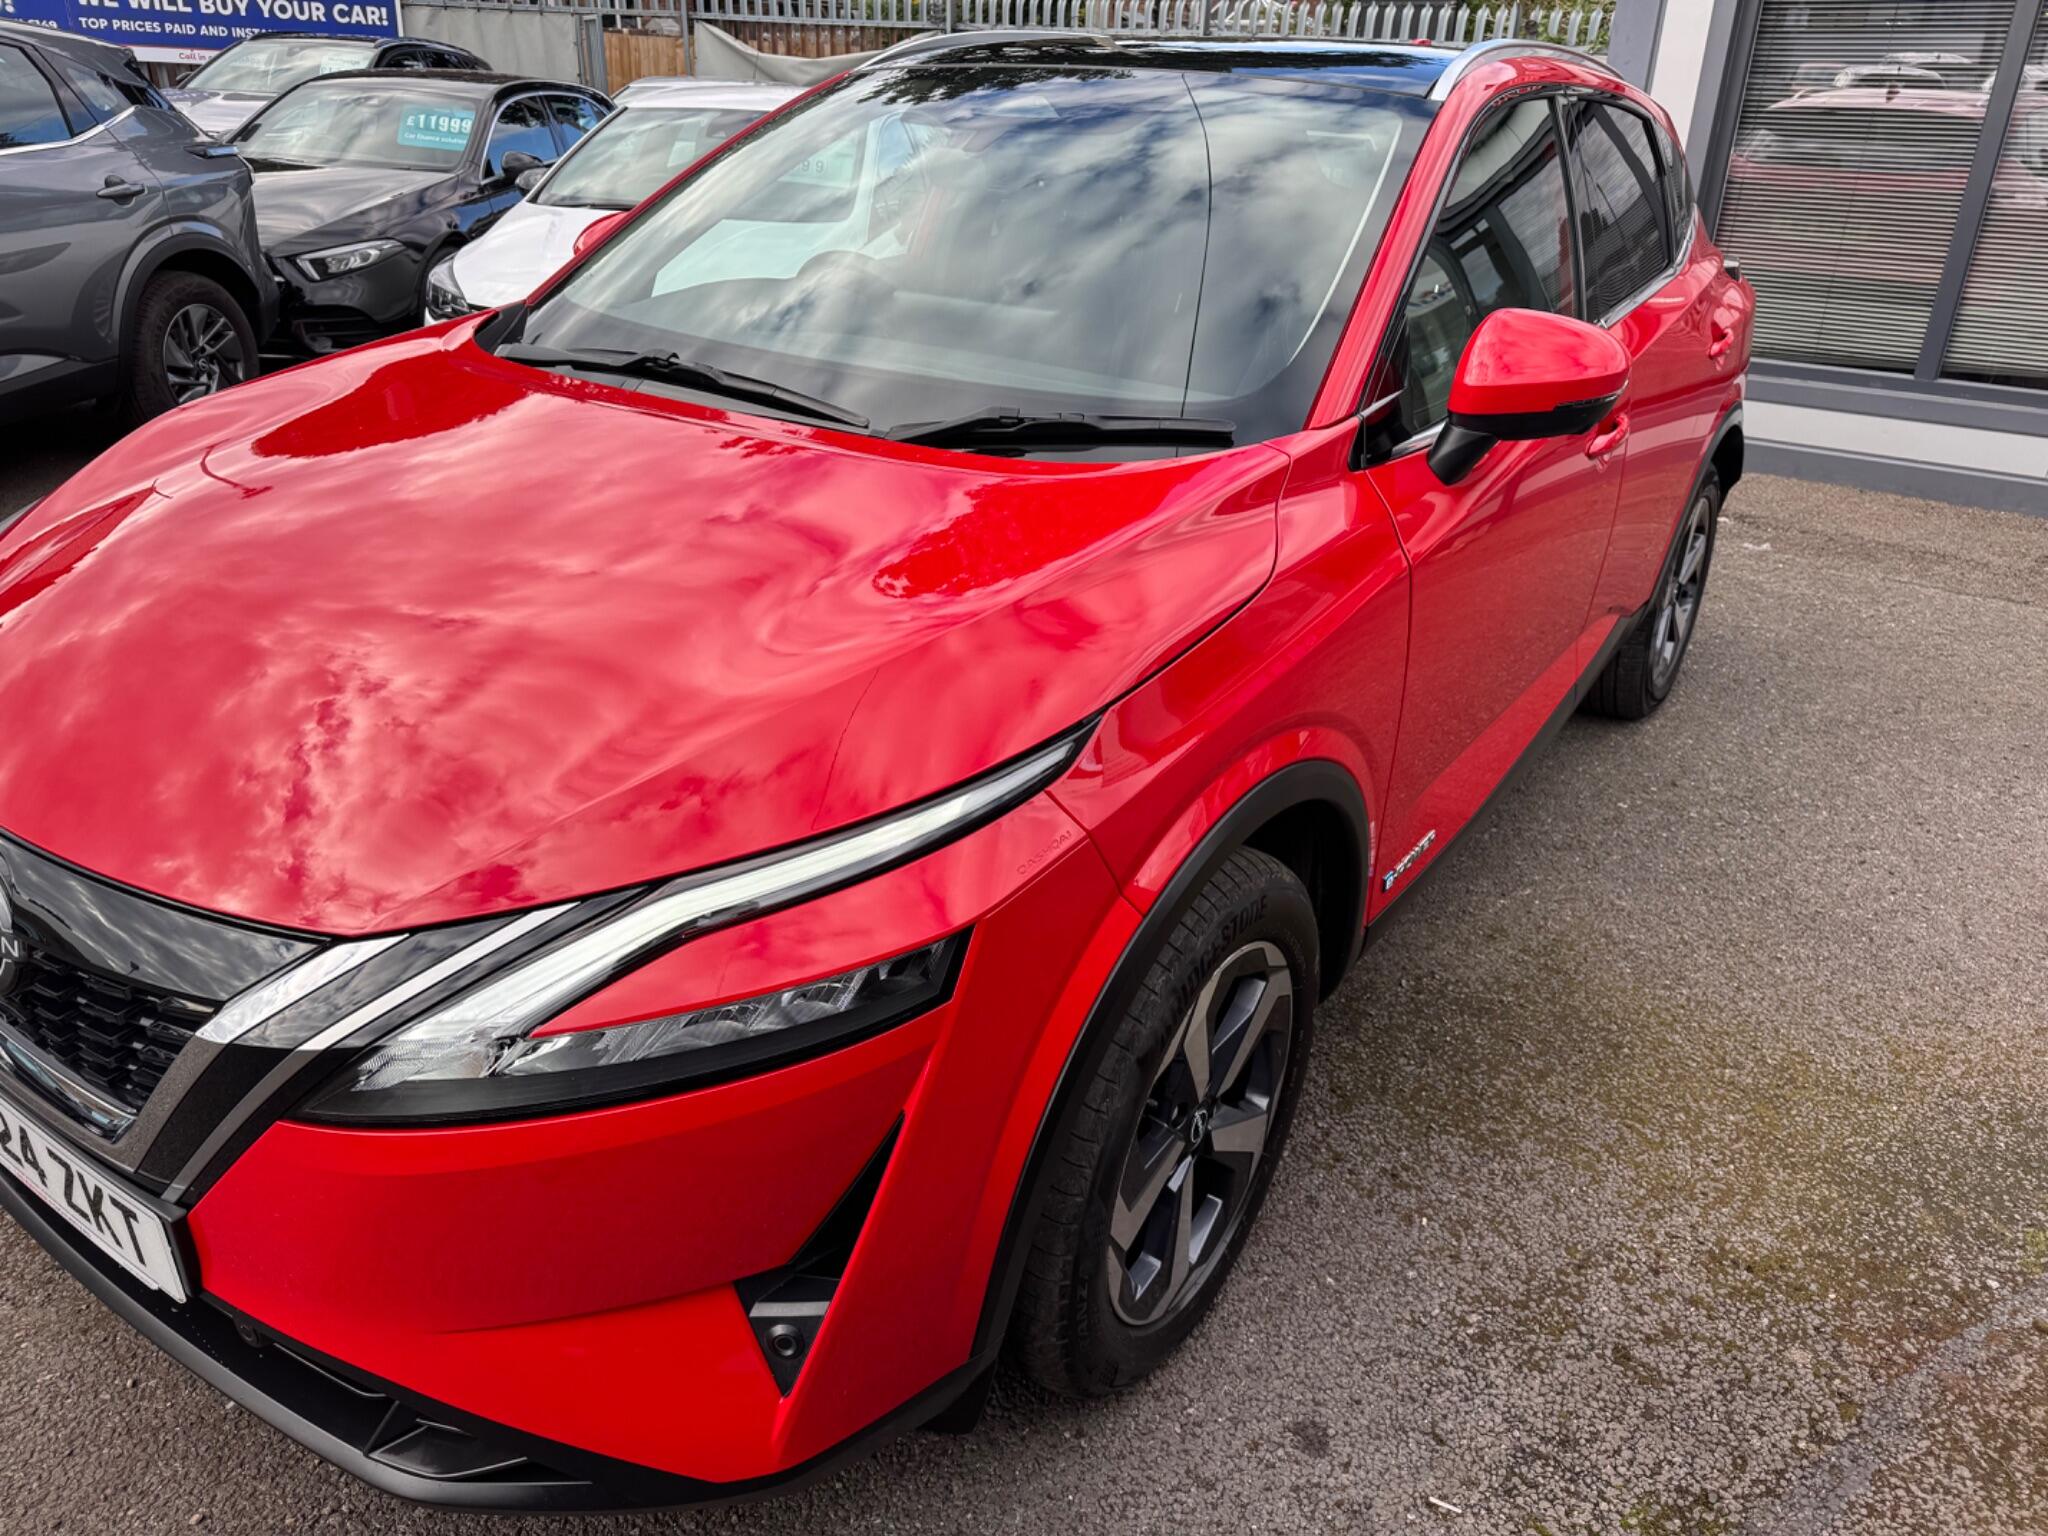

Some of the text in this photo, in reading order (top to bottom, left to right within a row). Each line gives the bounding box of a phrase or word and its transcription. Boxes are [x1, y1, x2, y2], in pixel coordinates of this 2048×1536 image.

[201, 0, 248, 16] BUY
[257, 0, 326, 21] YOUR
[333, 4, 389, 26] CAR!
[79, 17, 108, 29] TOP
[112, 20, 161, 33] PRICES
[165, 23, 196, 35] PAID
[200, 25, 228, 37] AND
[406, 113, 473, 134] £11999
[46, 1146, 147, 1268] ZKT
